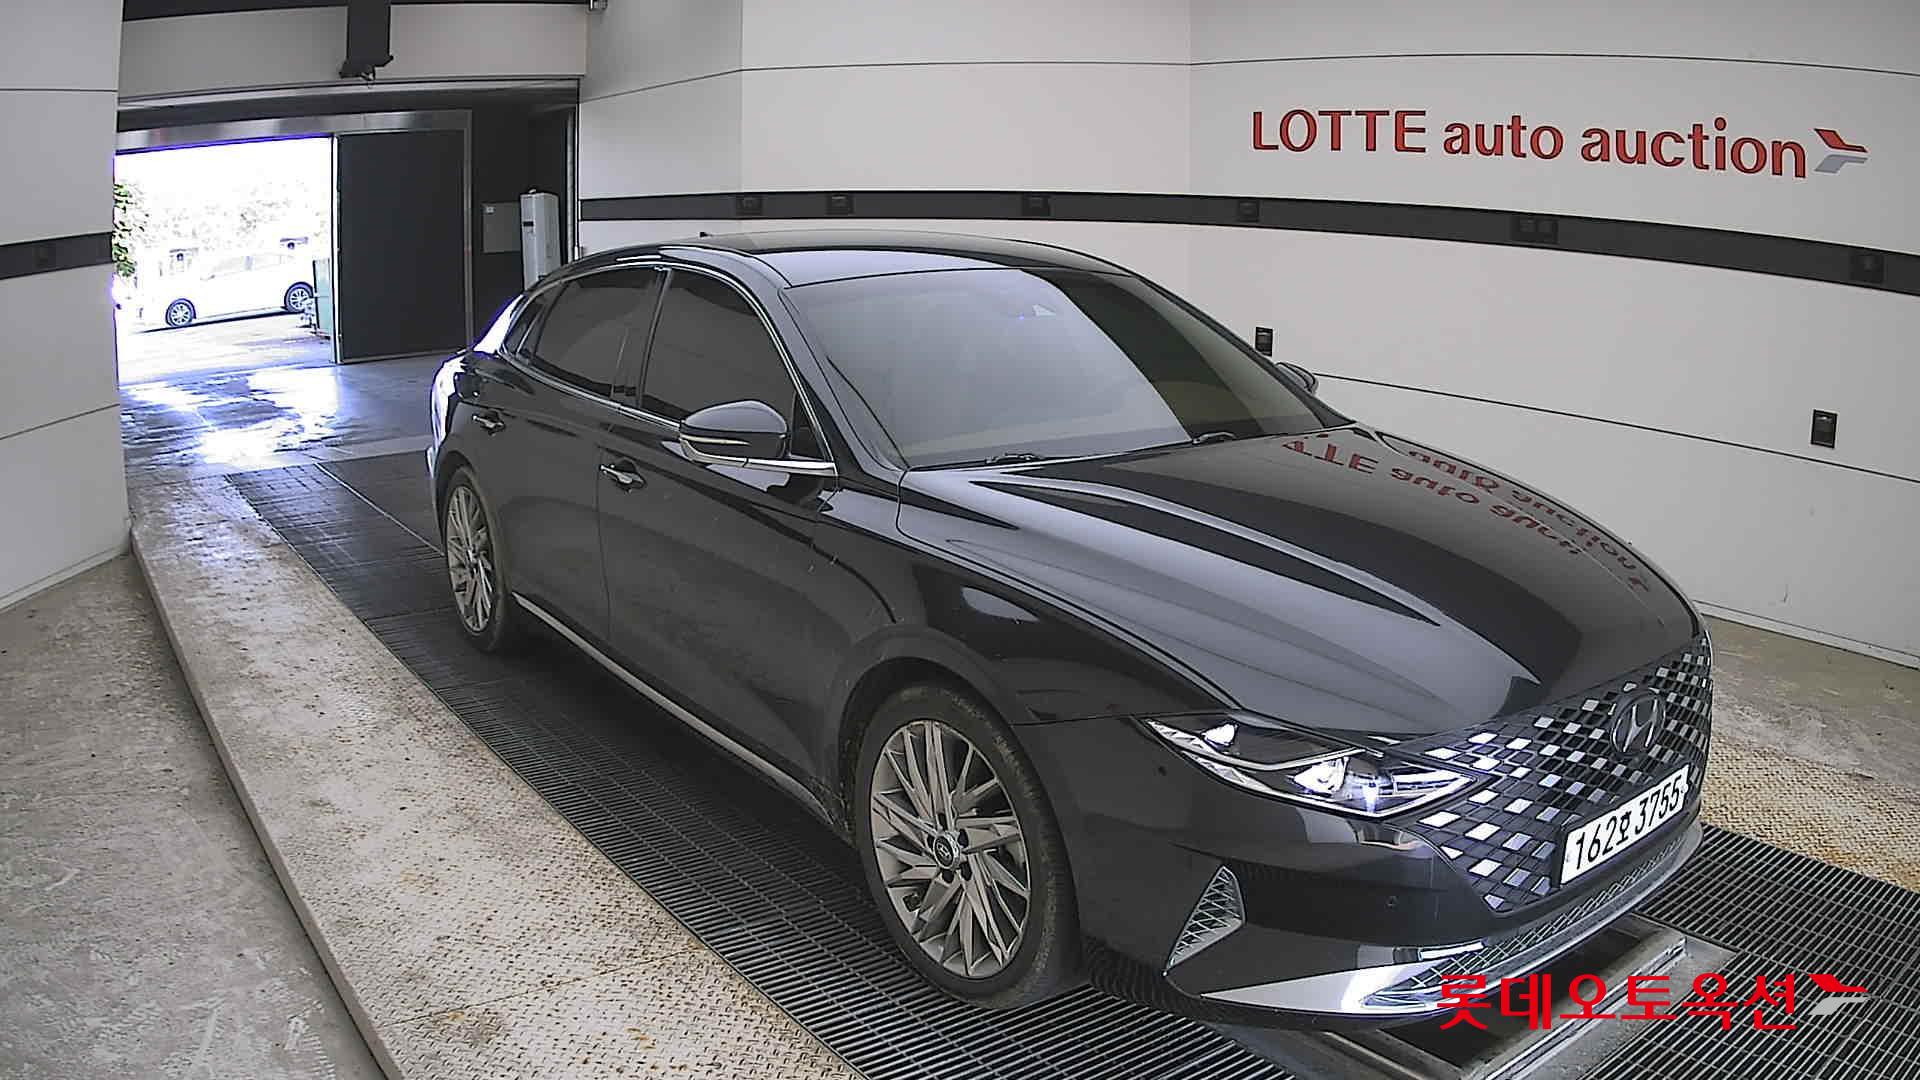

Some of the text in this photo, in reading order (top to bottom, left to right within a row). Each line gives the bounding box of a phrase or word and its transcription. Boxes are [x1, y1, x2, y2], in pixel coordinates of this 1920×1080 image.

[1252, 110, 1808, 178] LOTTE auto auction
[1635, 774, 1683, 835] 3755
